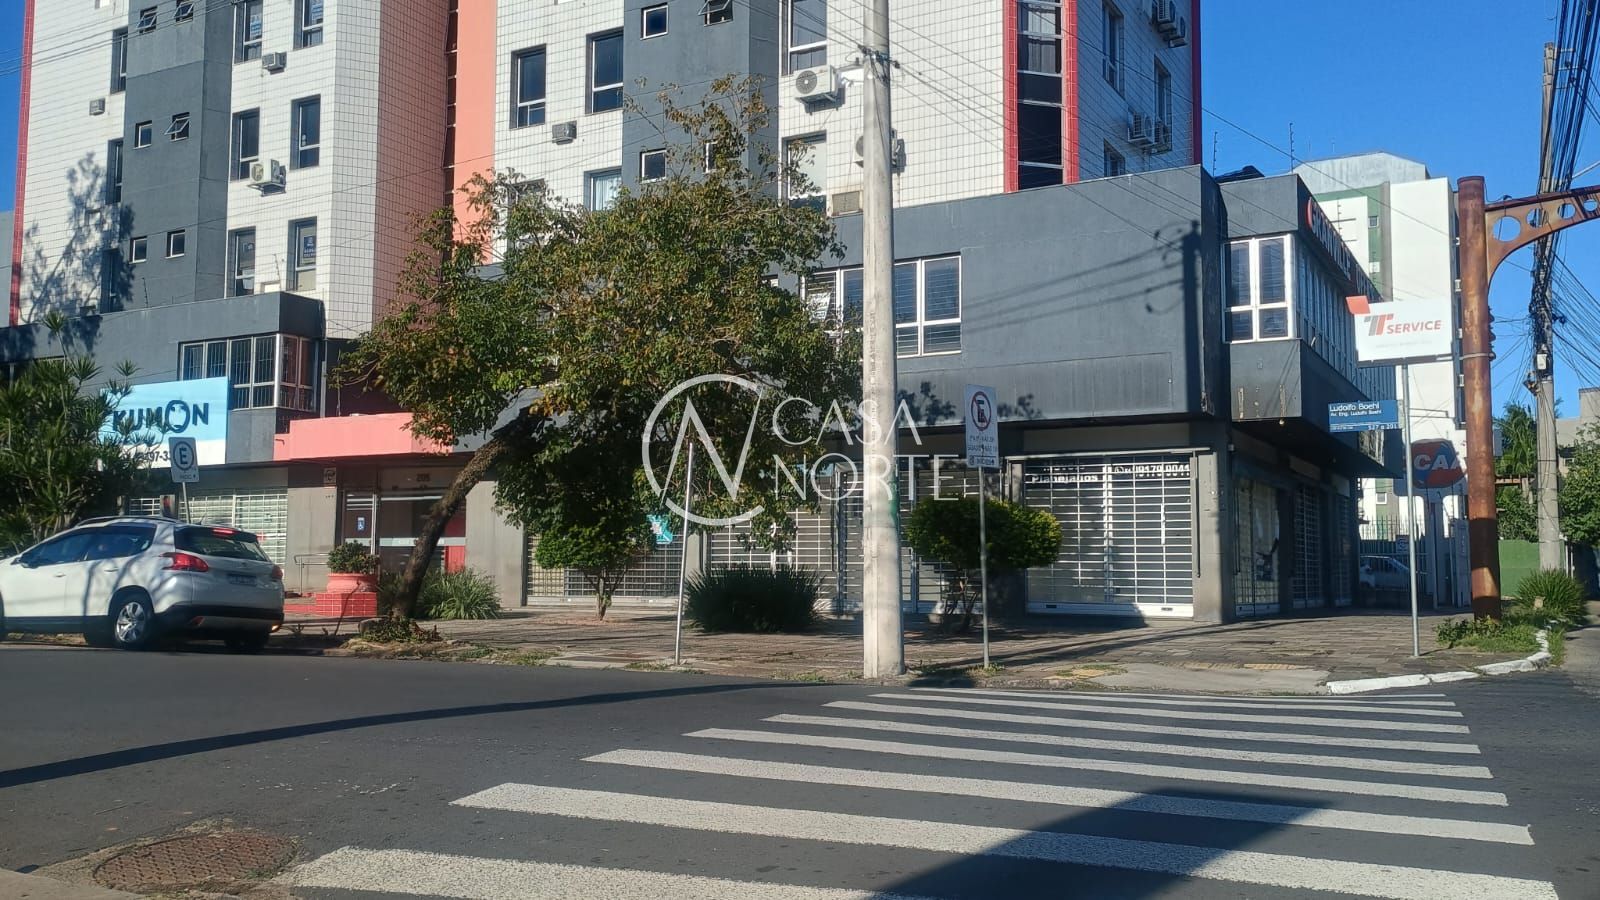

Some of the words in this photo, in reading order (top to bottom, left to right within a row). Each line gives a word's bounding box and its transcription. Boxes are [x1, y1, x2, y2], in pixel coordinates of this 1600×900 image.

[1387, 320, 1442, 335] SERVICE
[1329, 403, 1356, 412] Ludolfo
[112, 399, 210, 434] KUMON
[179, 447, 188, 465] E
